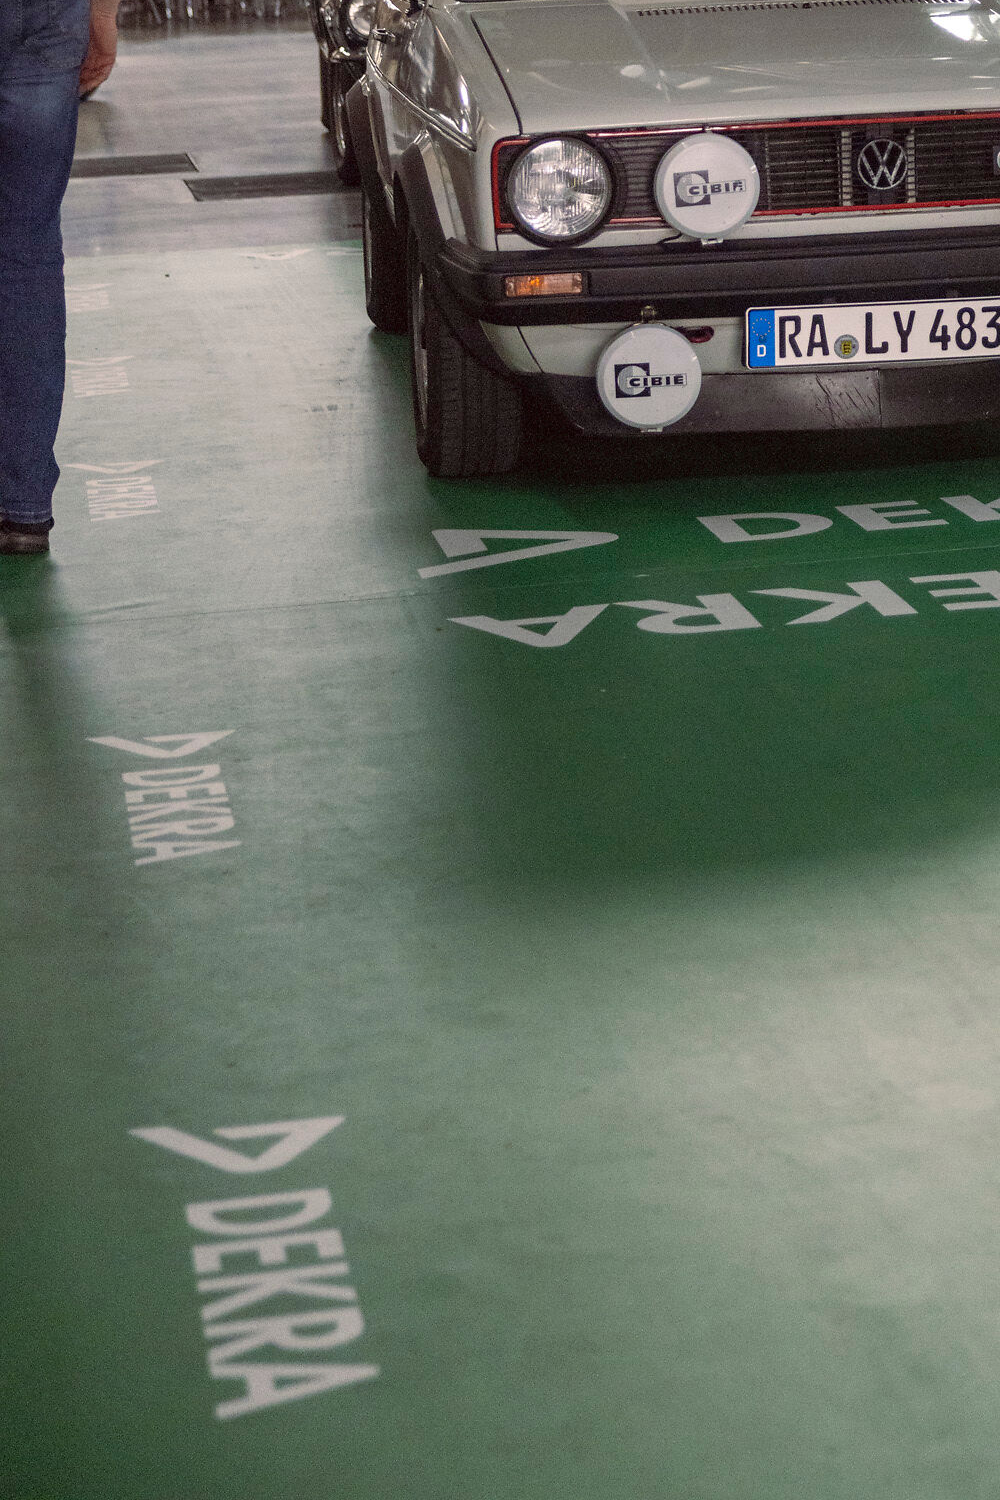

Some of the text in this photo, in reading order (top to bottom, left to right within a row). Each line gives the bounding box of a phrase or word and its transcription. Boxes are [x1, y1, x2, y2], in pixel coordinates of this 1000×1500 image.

[756, 344, 767, 358] D
[778, 314, 830, 359] RA
[865, 310, 916, 354] LY
[121, 763, 243, 866] DEKRA
[186, 1187, 381, 1420] DEKRA
